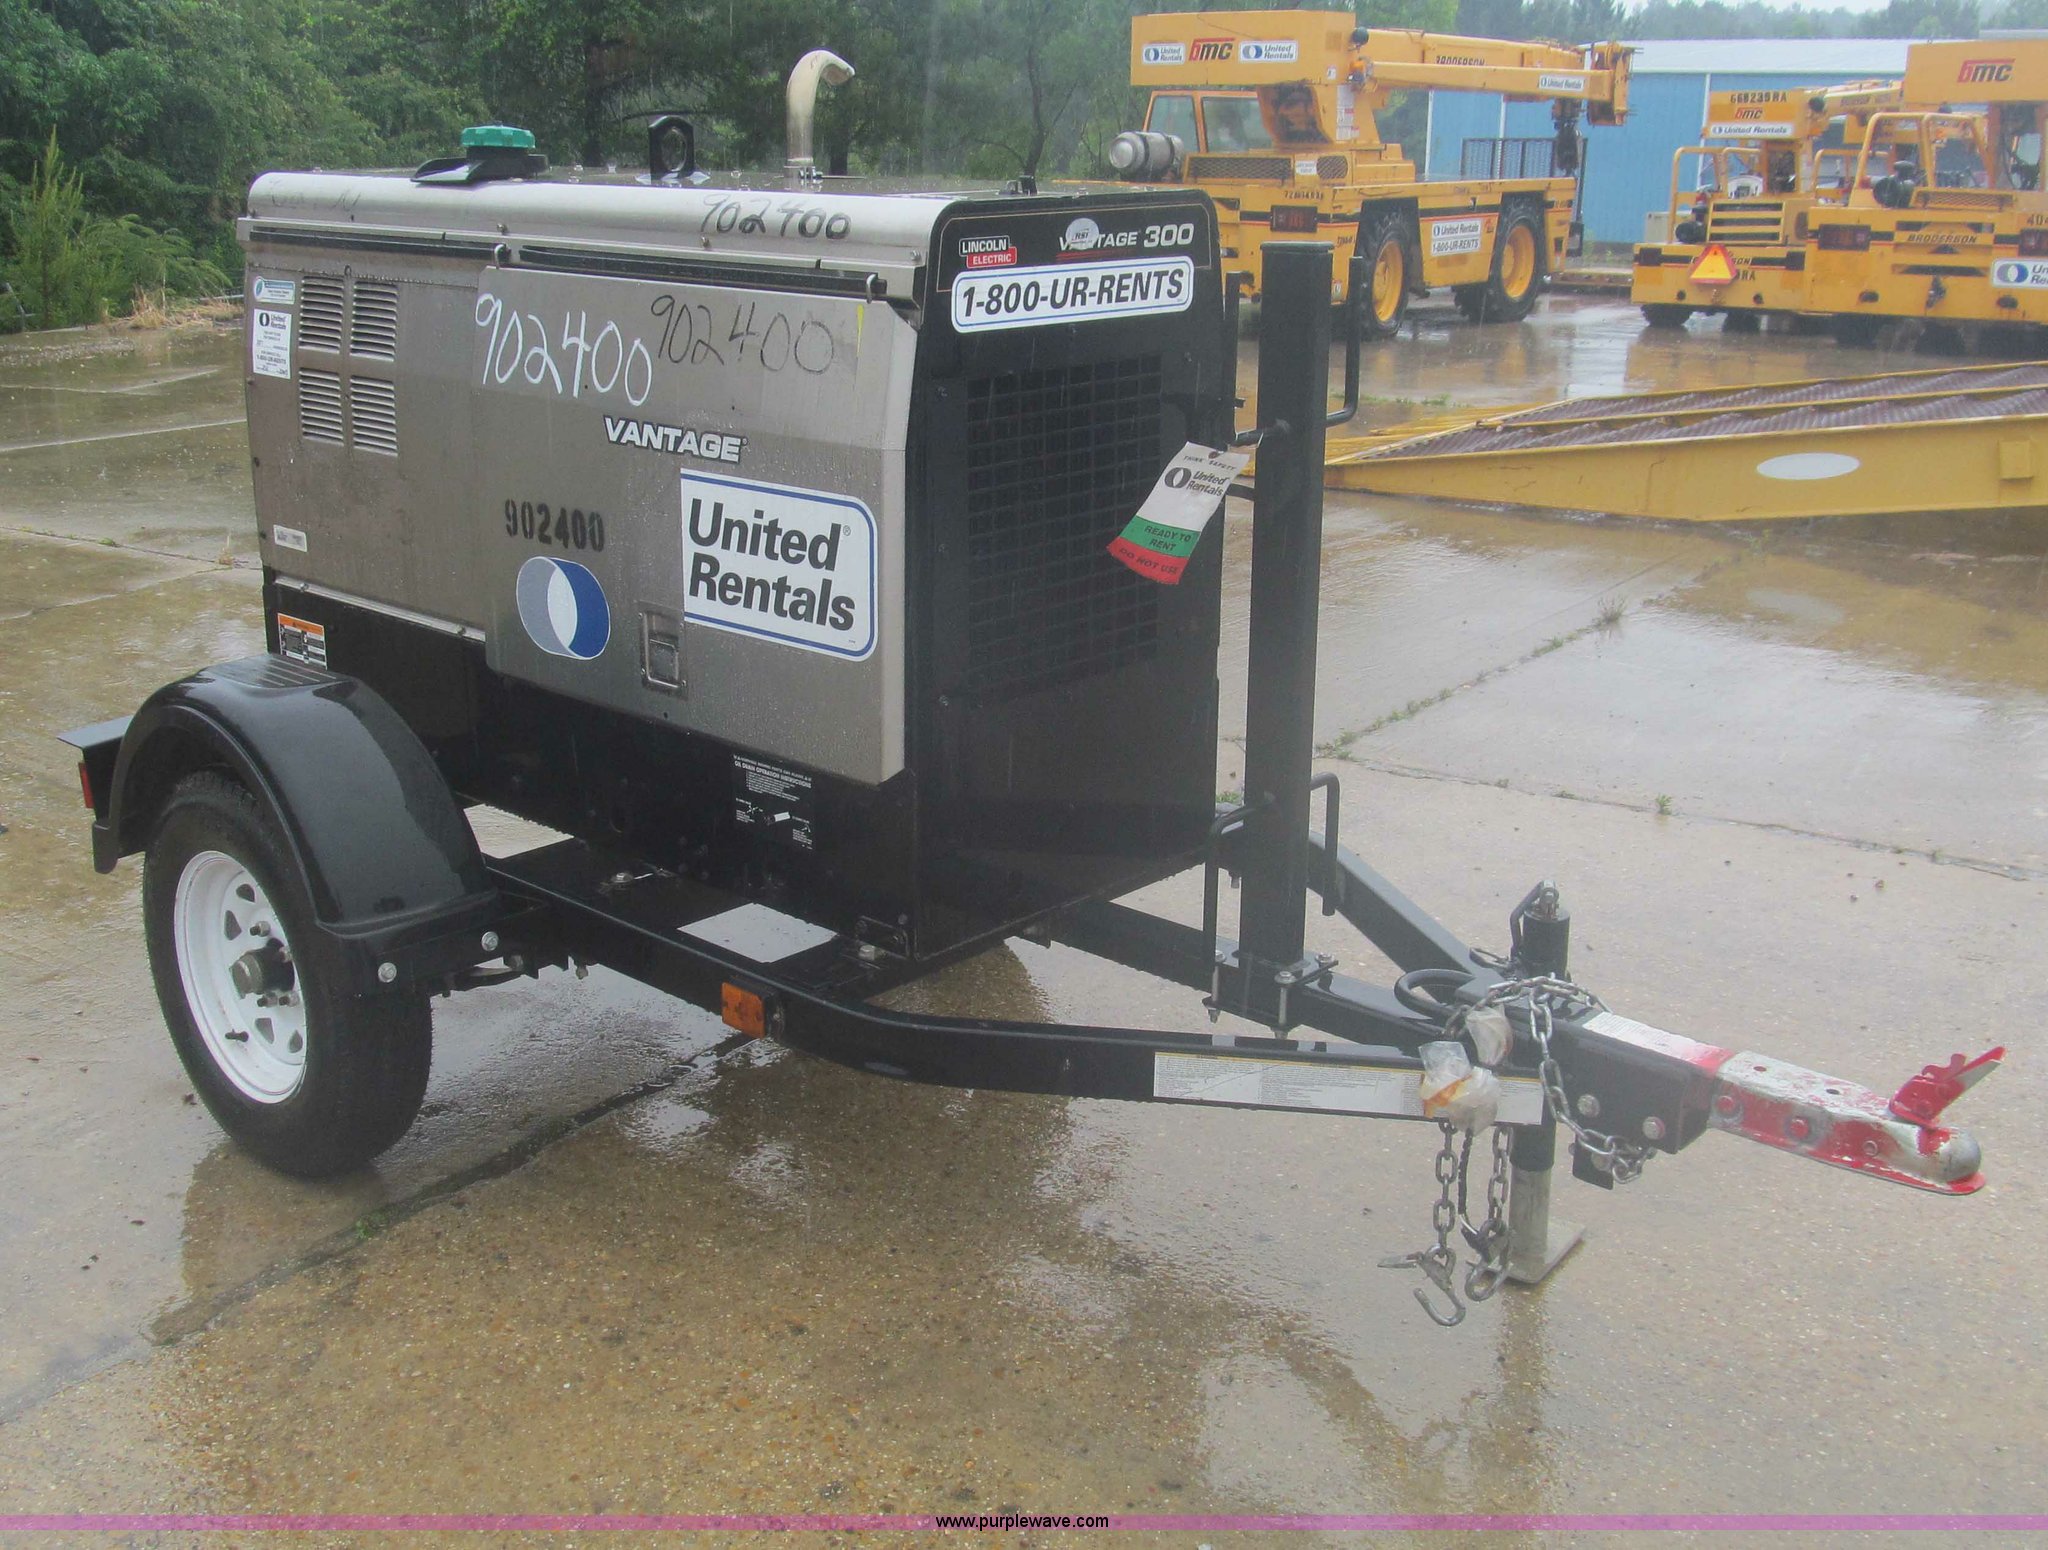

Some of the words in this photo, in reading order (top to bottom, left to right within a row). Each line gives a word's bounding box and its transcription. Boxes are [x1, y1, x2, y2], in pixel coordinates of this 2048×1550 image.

[1160, 53, 1183, 61] Rentals
[1263, 44, 1292, 53] United
[1264, 51, 1294, 59] Rentals
[701, 193, 851, 240] 902400
[1143, 222, 1195, 248] 300
[1907, 233, 1978, 244] BRODERSON
[962, 238, 1008, 254] LINCOLN
[972, 252, 1013, 266] ELECTRIC
[962, 267, 1184, 318] 1-800-UR-RENTS
[475, 293, 652, 407] 902400
[651, 294, 834, 375] 902400
[604, 416, 742, 464] VANTAGE
[1192, 470, 1227, 485] United
[1186, 480, 1224, 497] Rentals
[504, 498, 606, 552] 902400
[1144, 525, 1179, 539] READY
[1179, 533, 1192, 542] TO
[688, 497, 842, 571] United
[1148, 538, 1177, 551] RENT
[1119, 547, 1135, 559] DO
[1137, 555, 1159, 570] NOT
[688, 552, 856, 632] Rentals
